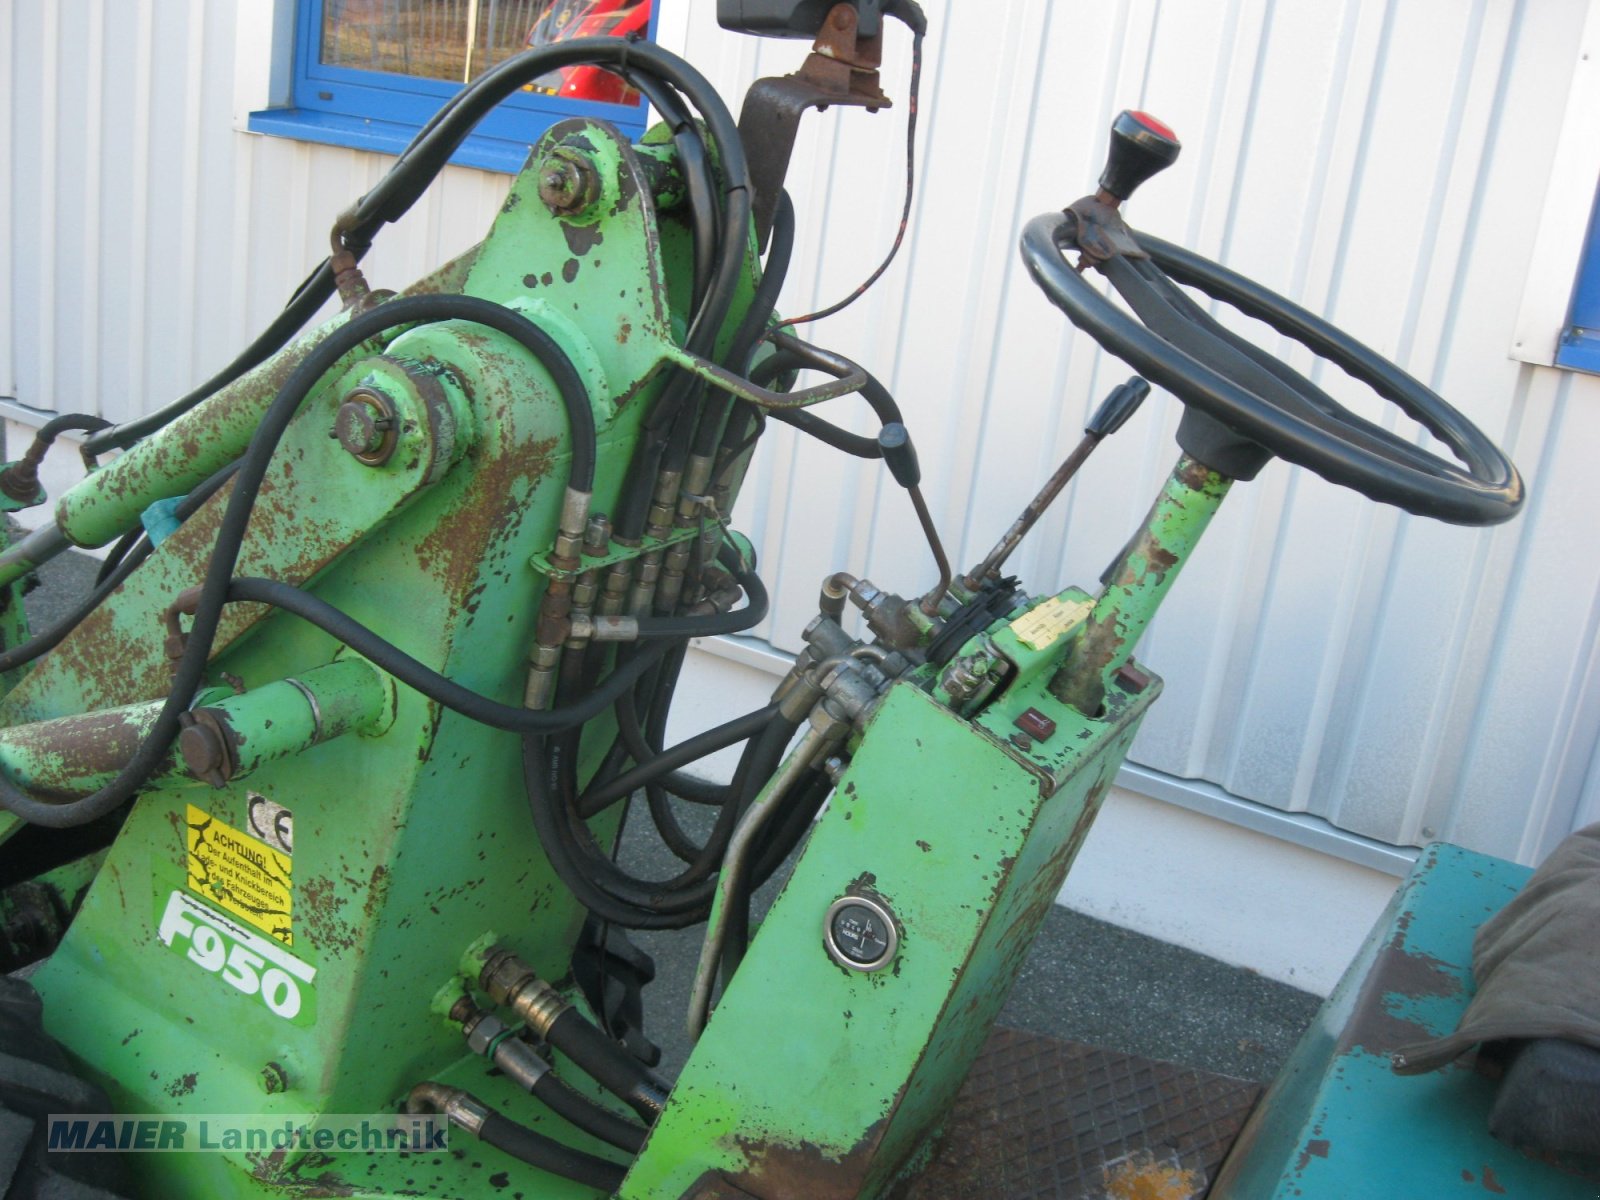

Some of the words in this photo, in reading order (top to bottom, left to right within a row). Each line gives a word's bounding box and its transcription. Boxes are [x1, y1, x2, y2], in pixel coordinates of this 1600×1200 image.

[249, 796, 292, 853] CE
[208, 843, 221, 857] Der
[222, 852, 261, 881] Aufenthalt
[263, 875, 273, 887] im
[213, 831, 266, 868] ACHTUNG!
[219, 864, 233, 877] und
[235, 871, 285, 906] Knickbereich
[226, 879, 270, 910] Fahrzeuges
[157, 890, 316, 1019] F950
